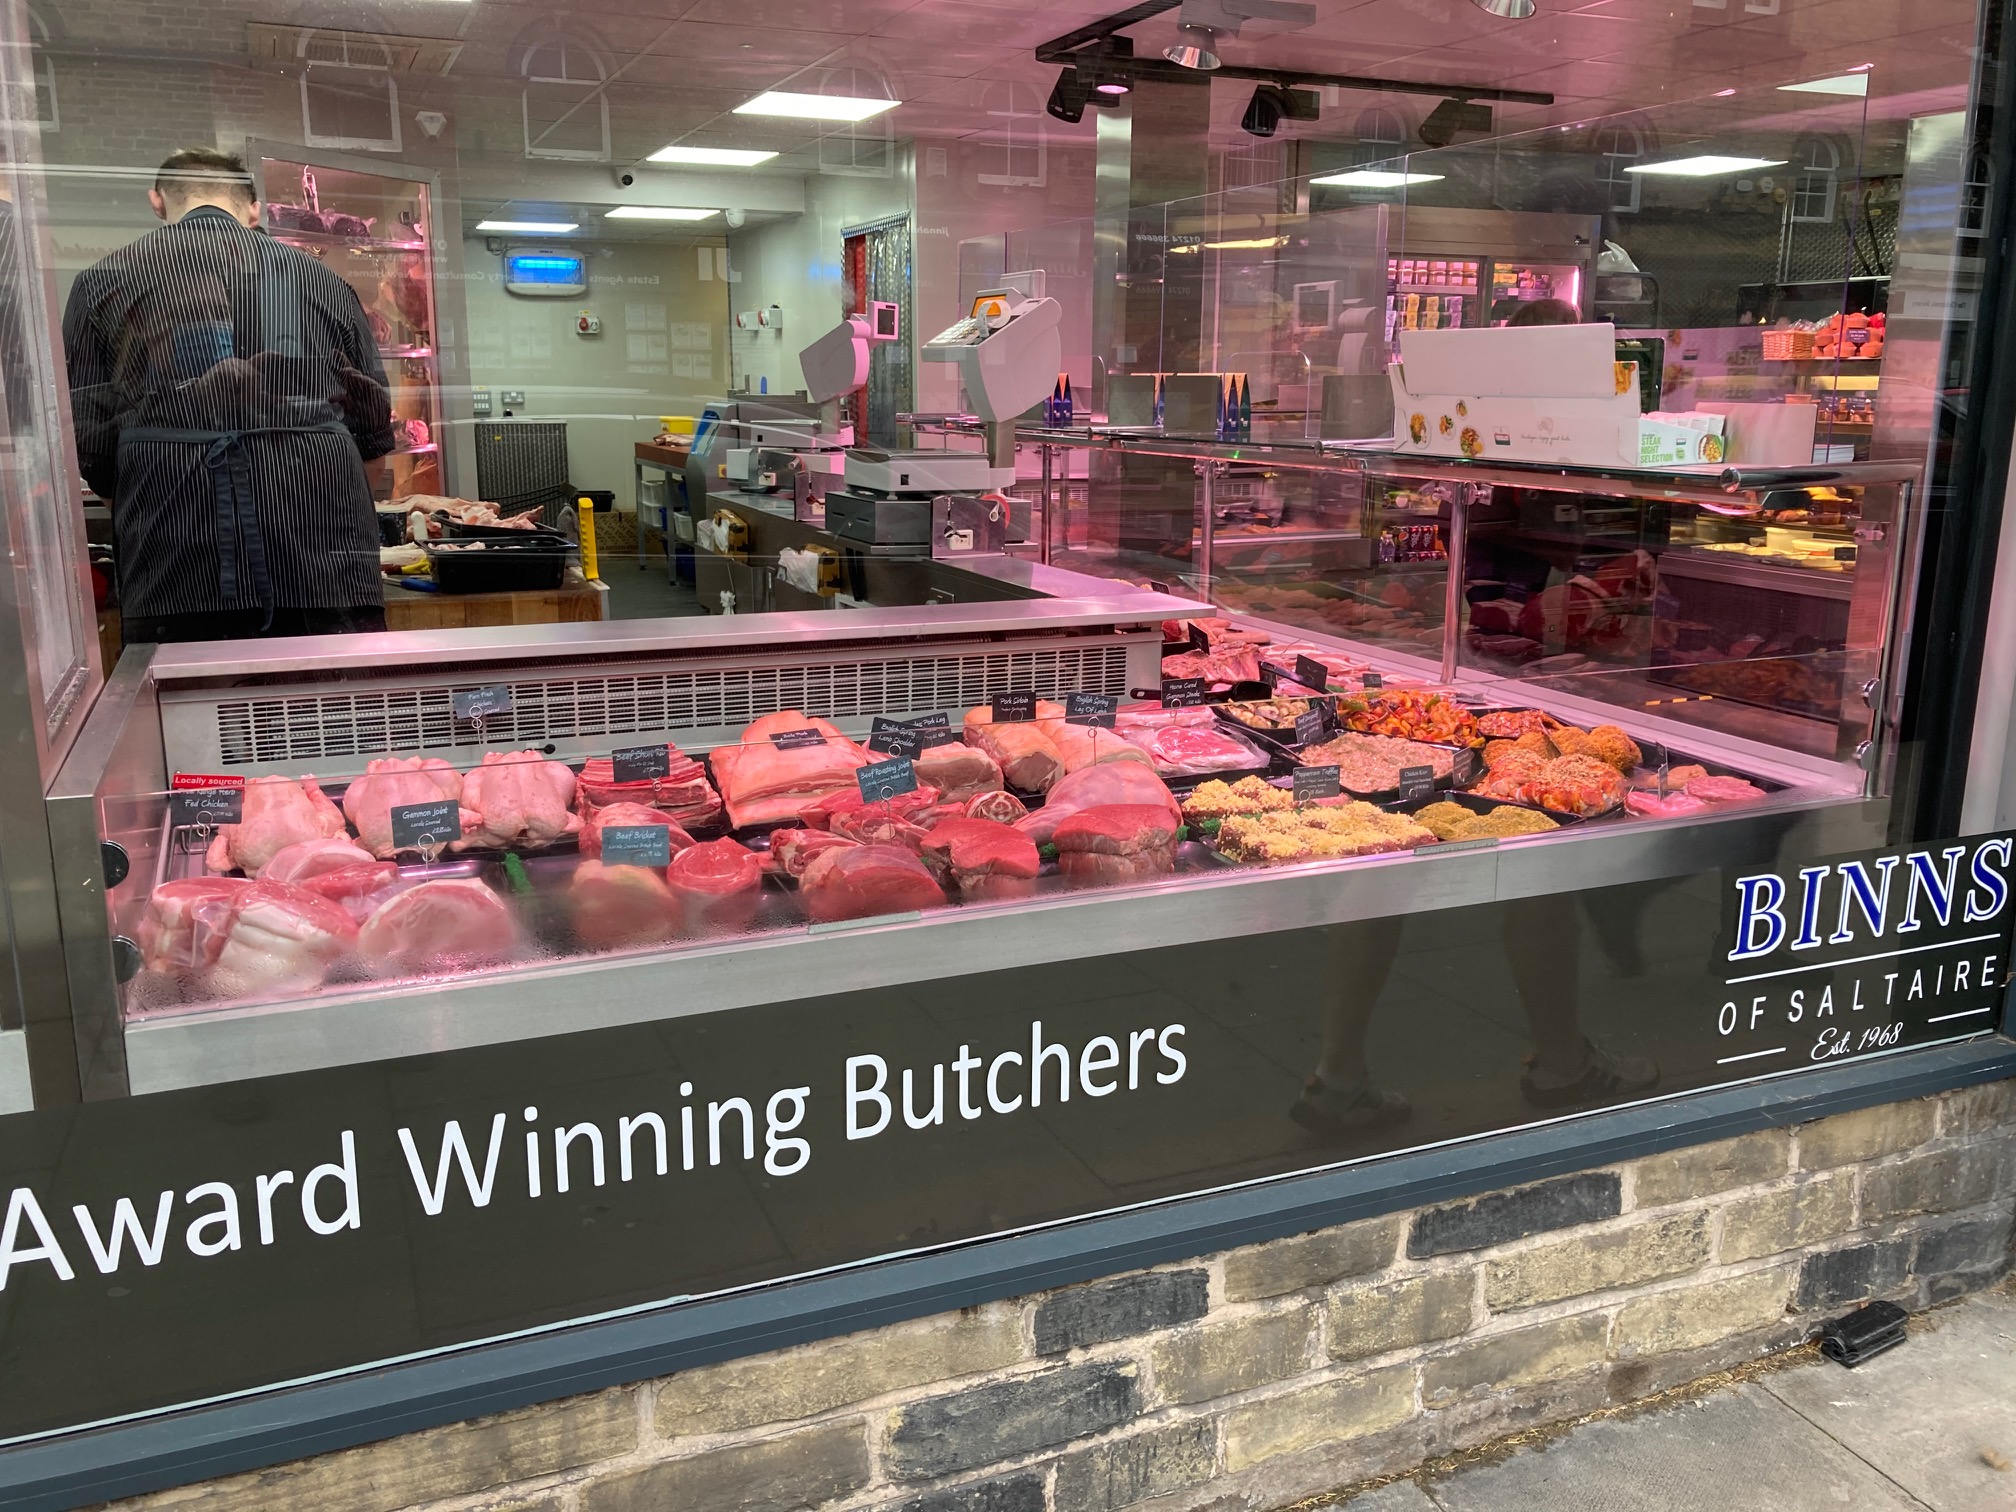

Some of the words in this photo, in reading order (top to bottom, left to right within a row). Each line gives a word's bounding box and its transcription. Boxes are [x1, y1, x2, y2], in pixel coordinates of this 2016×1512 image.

[1641, 436, 1661, 446] STEAK
[1641, 446, 1659, 455] NIGHT
[1641, 453, 1673, 464] SELECTION
[1074, 706, 1085, 714] Leg
[936, 717, 946, 725] Leg
[174, 776, 207, 786] Locally
[208, 778, 244, 786] sourced
[184, 799, 200, 808] Fed
[200, 799, 229, 808] Chicken
[402, 810, 431, 820] Gammon
[431, 806, 449, 817] Joint
[615, 830, 633, 841] Beef
[1728, 838, 2013, 961] BINNS
[1718, 996, 1767, 1036] OF
[1788, 955, 1997, 1023] SALTAIRE
[1810, 1027, 1851, 1060] Est.
[1857, 1022, 1904, 1050] 1968
[0, 1130, 361, 1291] Award
[397, 1081, 811, 1217] Winning
[845, 1020, 1187, 1141] Butchers
